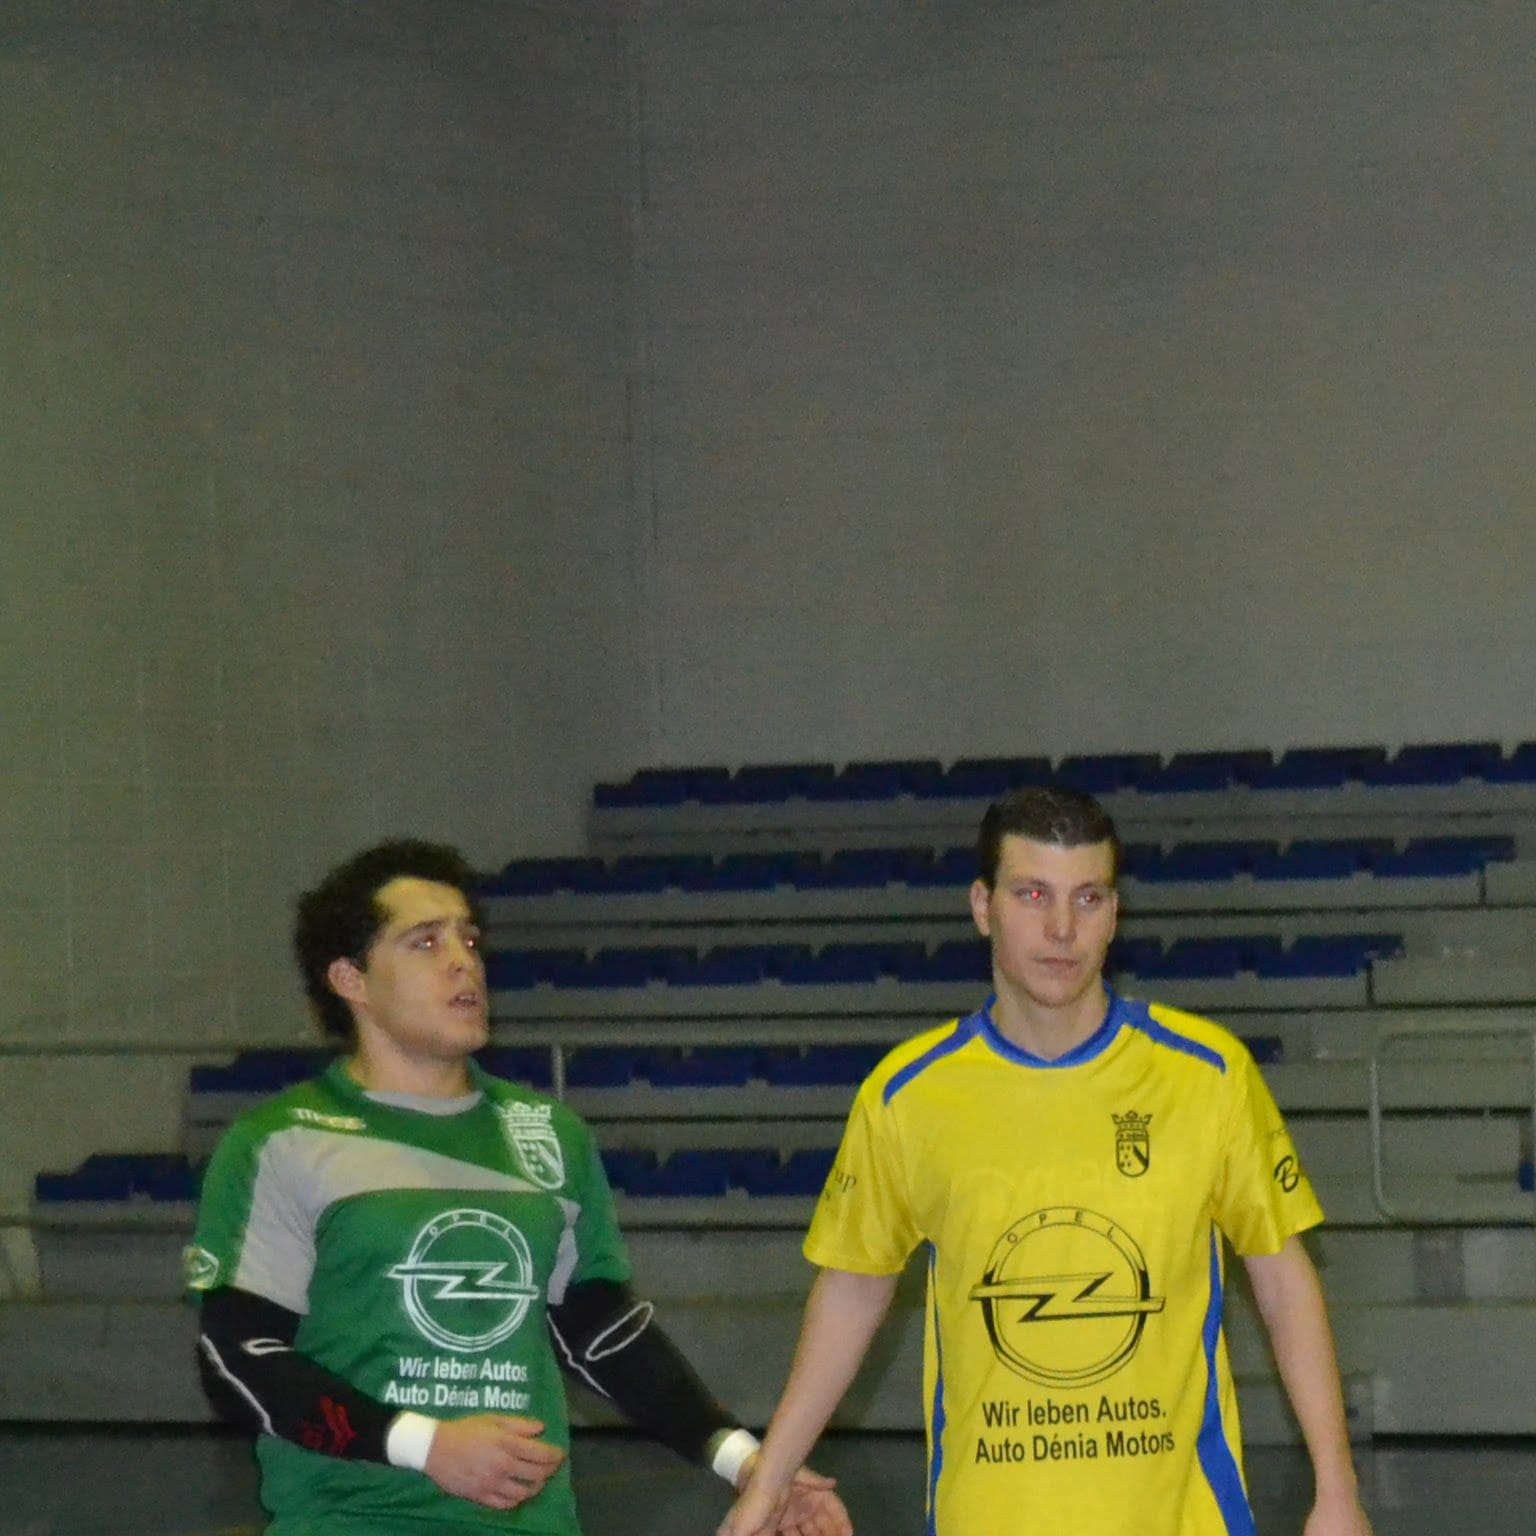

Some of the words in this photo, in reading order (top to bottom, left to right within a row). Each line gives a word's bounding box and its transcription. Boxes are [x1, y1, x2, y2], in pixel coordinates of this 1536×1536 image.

[1007, 1210, 1116, 1246] OPEL
[399, 1356, 430, 1378] Wir
[433, 1356, 478, 1380] leben
[384, 1380, 430, 1406] Auto
[982, 1401, 1020, 1428] Wir
[1027, 1398, 1090, 1426] leben
[975, 1436, 1025, 1464] Auto
[1032, 1433, 1098, 1462] Dénia
[1105, 1430, 1175, 1457] Motors
